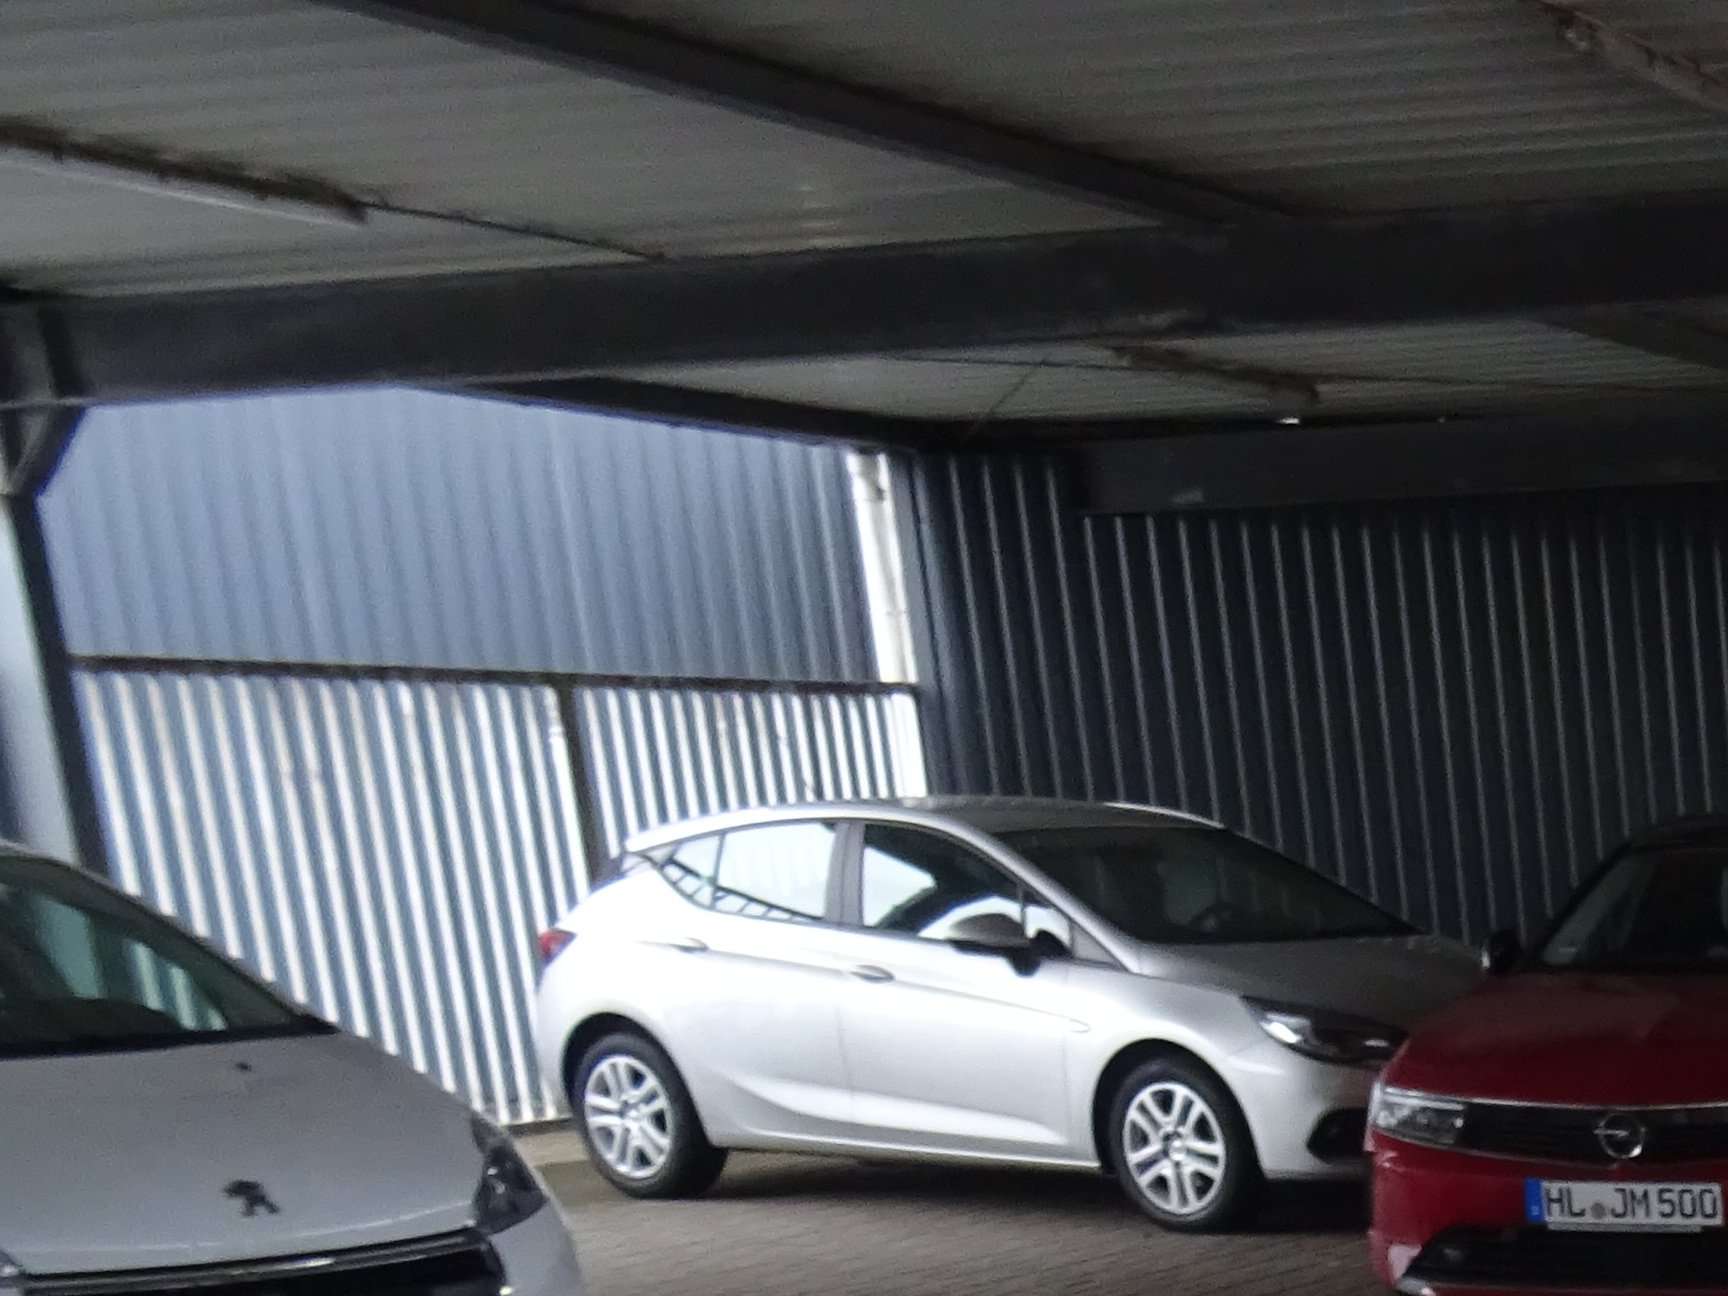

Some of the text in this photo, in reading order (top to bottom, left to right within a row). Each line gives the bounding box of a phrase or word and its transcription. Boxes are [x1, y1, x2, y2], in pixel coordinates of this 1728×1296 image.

[1545, 1186, 1719, 1219] HL JM 500
